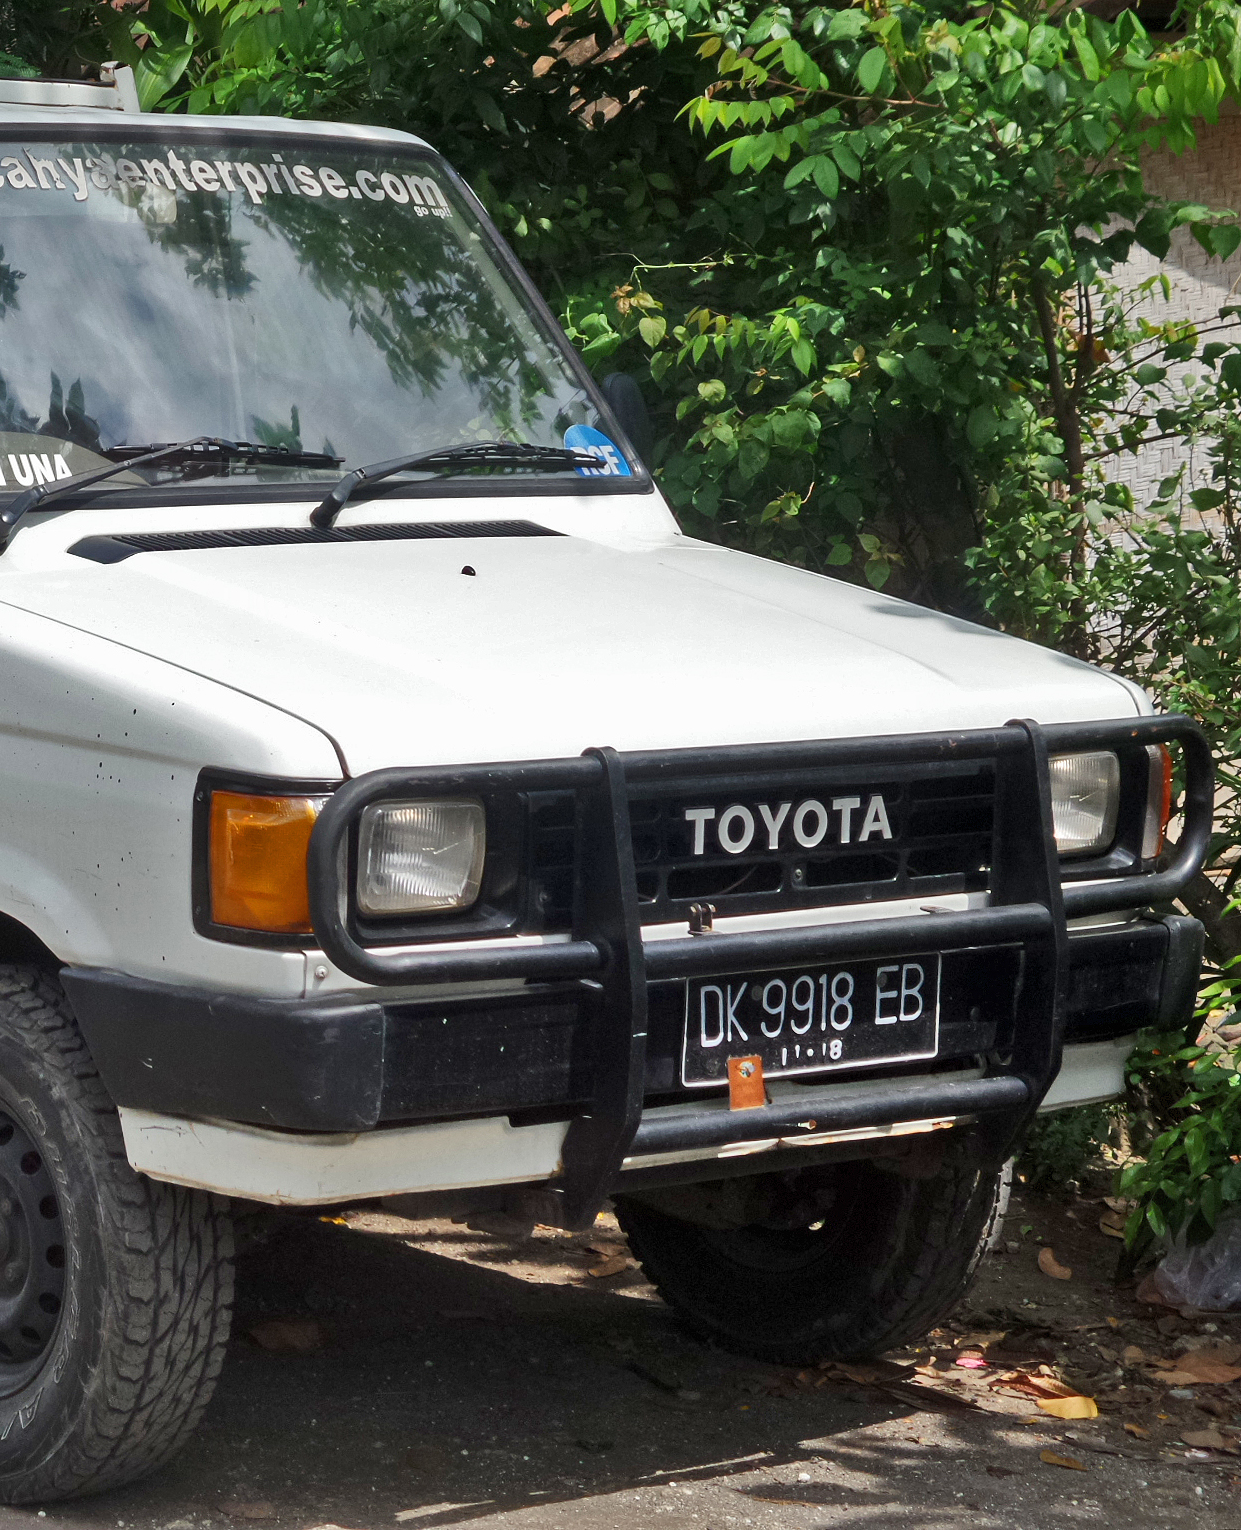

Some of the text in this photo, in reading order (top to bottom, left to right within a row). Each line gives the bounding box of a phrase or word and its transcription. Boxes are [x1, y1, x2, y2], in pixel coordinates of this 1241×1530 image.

[685, 794, 893, 855] TOYOTA
[700, 963, 925, 1048] DK 9918 EB
